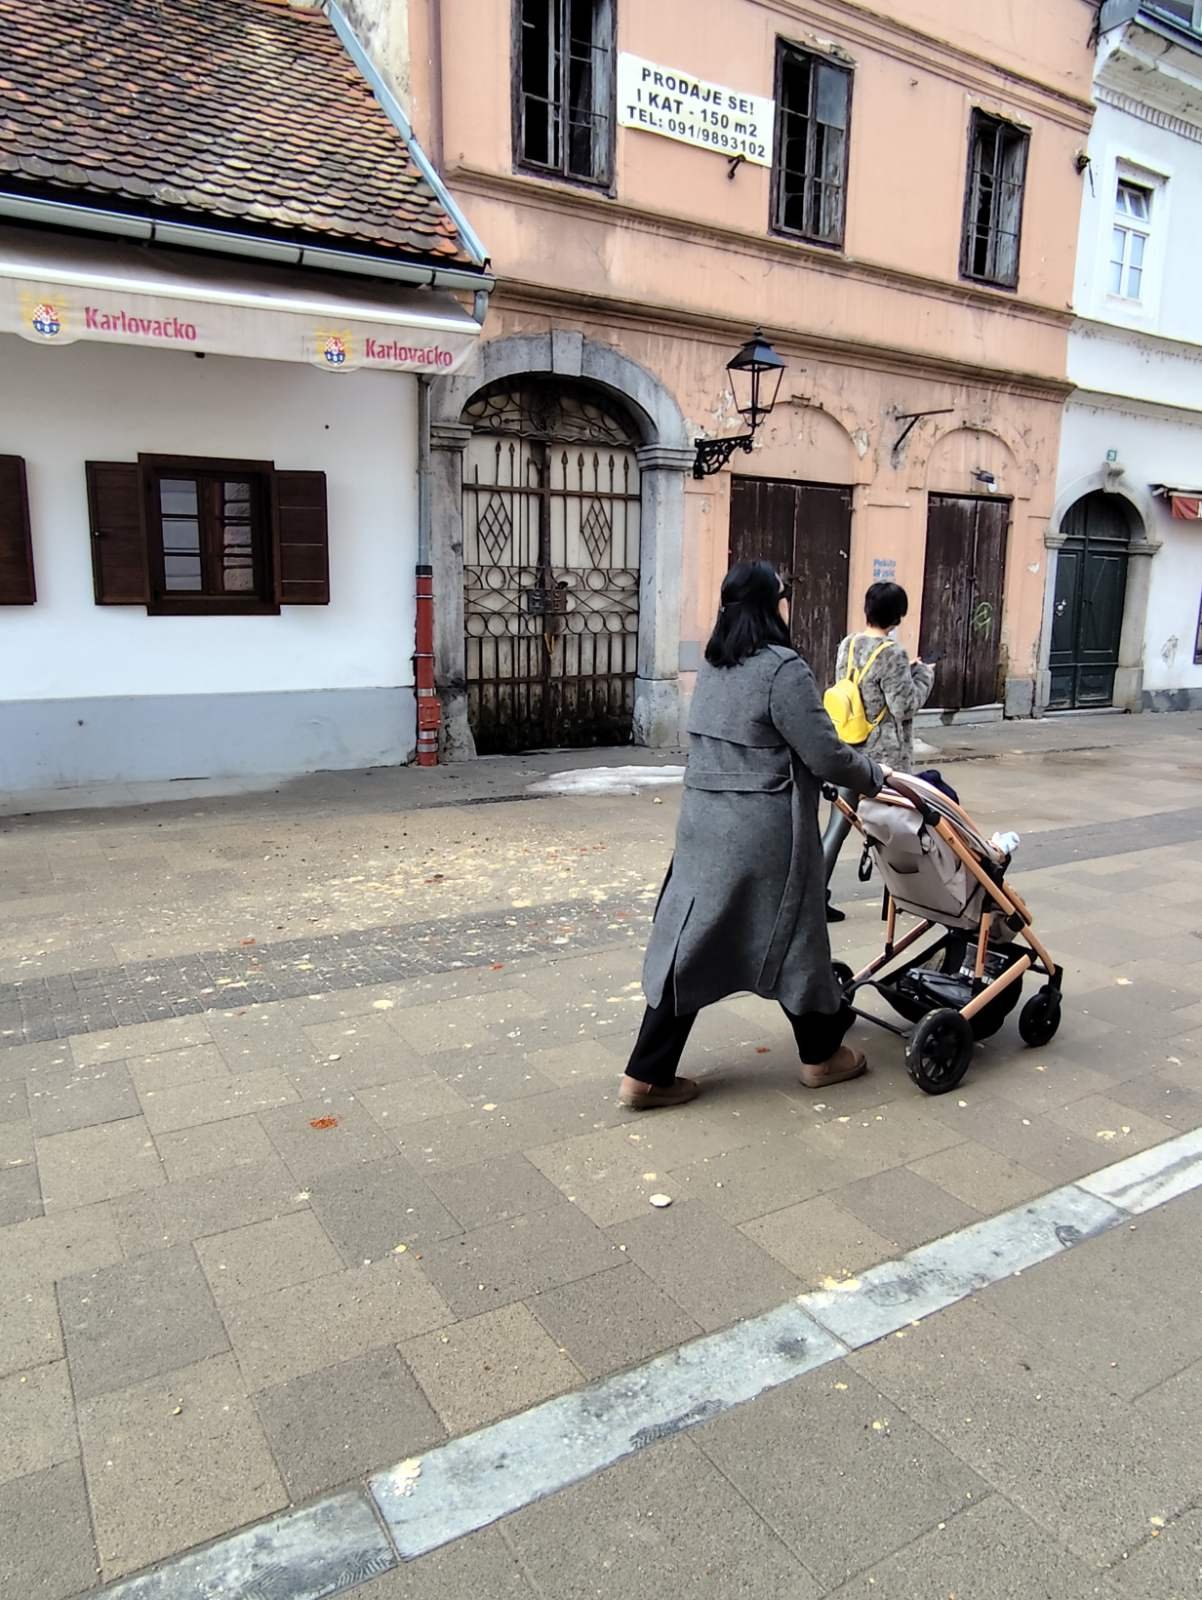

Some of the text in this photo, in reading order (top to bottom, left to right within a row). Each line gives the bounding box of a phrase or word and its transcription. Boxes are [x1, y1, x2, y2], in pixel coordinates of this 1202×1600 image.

[637, 88, 641, 102] I
[648, 92, 683, 115] KAT
[700, 109, 729, 129] 150
[734, 122, 757, 137] m2
[642, 67, 754, 115] PRODAJE SE!
[627, 105, 766, 157] TEL: 091/9893102
[84, 306, 197, 341] Karlovačko
[365, 338, 453, 367] Karlovačko
